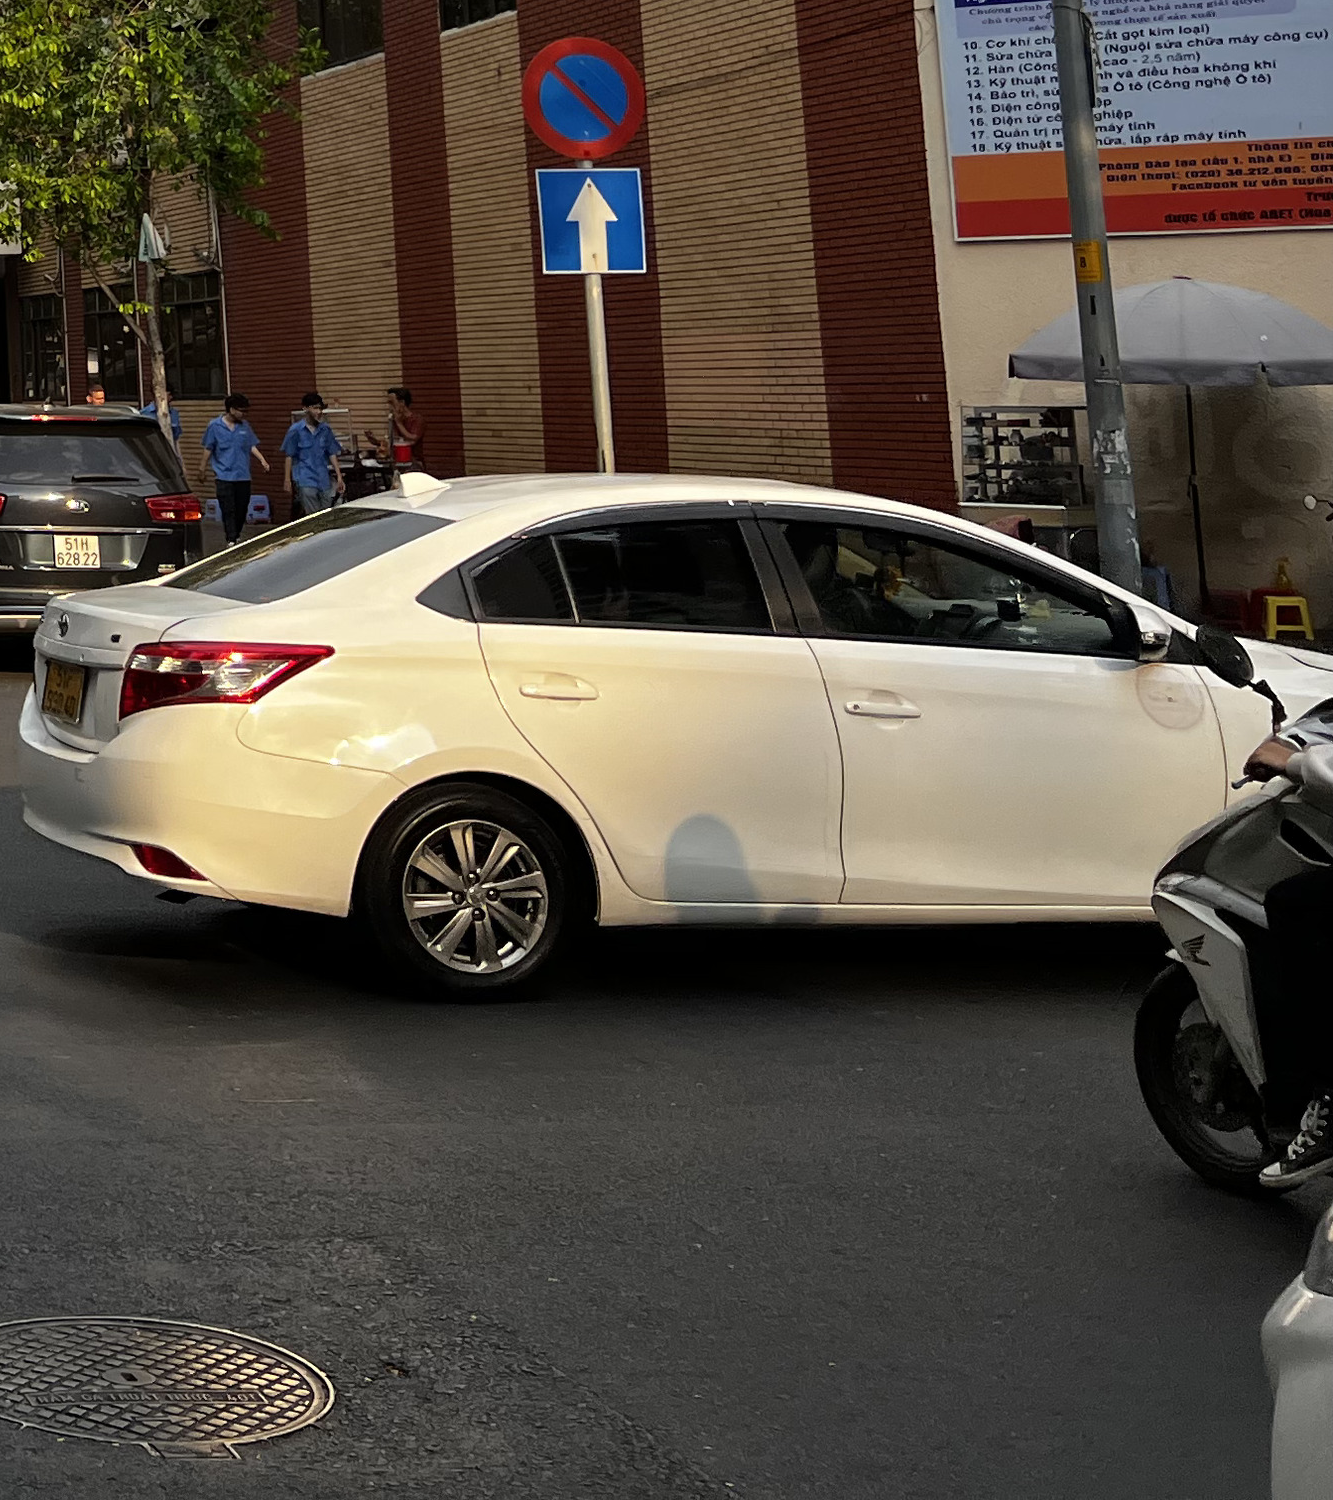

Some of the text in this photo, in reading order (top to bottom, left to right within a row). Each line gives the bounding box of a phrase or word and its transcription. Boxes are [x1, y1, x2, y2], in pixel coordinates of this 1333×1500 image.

[1148, 27, 1174, 36] kim
[1263, 32, 1300, 41] công
[64, 537, 89, 552] 51H
[56, 551, 99, 567] 628.22
